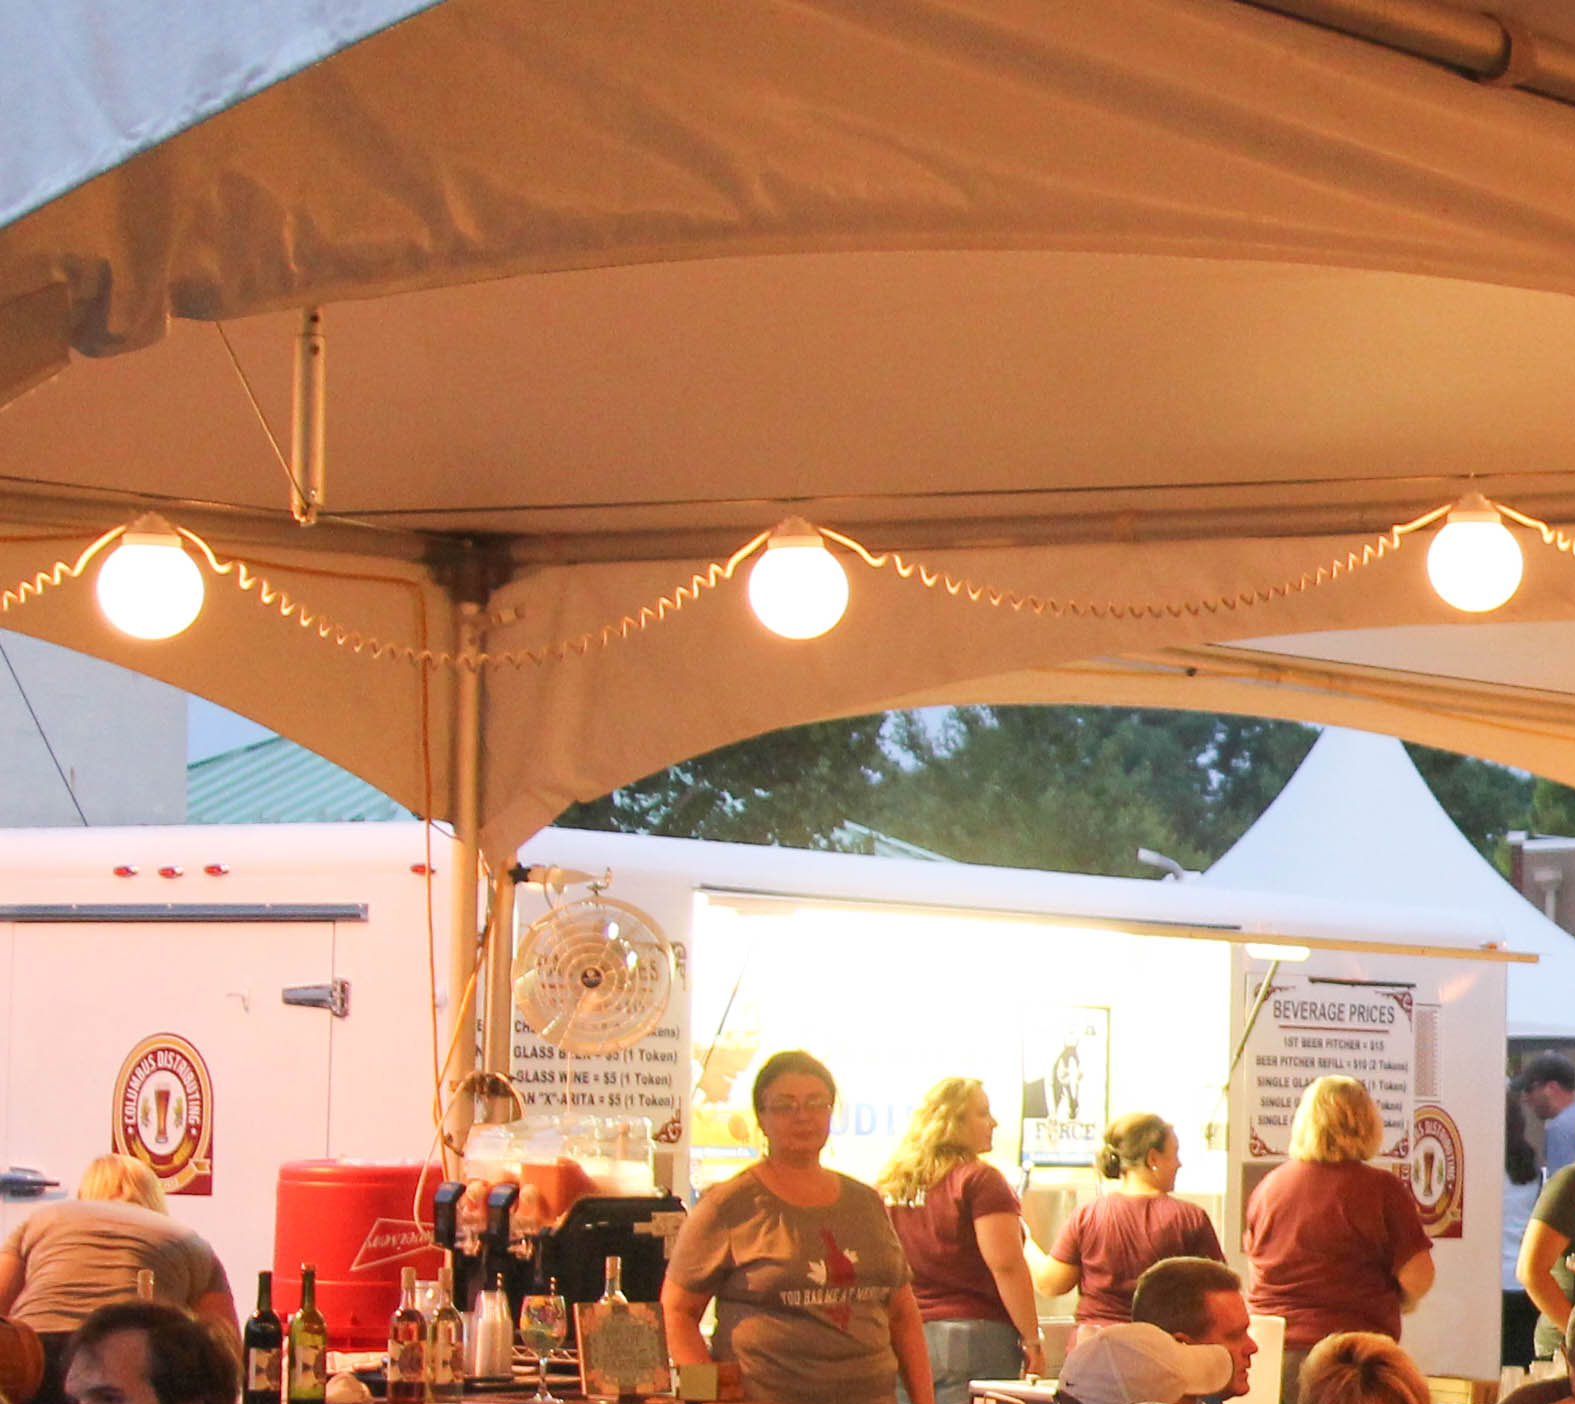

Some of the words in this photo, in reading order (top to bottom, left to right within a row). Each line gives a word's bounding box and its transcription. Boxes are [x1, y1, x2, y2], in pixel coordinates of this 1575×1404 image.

[1273, 1000, 1345, 1021] BEVERAGE
[1350, 1004, 1395, 1024] PRICES
[1284, 1036, 1299, 1048] 1ST
[1301, 1037, 1323, 1049] BEER
[1325, 1038, 1360, 1050] PITCHER
[514, 1045, 554, 1060] GLASS
[639, 1049, 678, 1065] Token)
[1256, 1055, 1278, 1067] BEER
[1280, 1056, 1315, 1068] PITCHER
[1317, 1057, 1344, 1069] REFILL
[516, 1069, 555, 1084] GLASS
[559, 1071, 591, 1085] WNE
[603, 1072, 617, 1086] $5
[635, 1074, 672, 1088] Token)
[1257, 1076, 1290, 1088] SINGLE
[1292, 1077, 1313, 1089] GLA
[124, 1053, 156, 1124] COLUMBUS
[157, 1050, 201, 1125] DISTRIBUTING
[608, 1093, 621, 1107] $5
[638, 1095, 675, 1110] Token)
[1260, 1096, 1292, 1108] SINGLE
[1258, 1114, 1289, 1126] SINGLE
[780, 1290, 800, 1306] YOU
